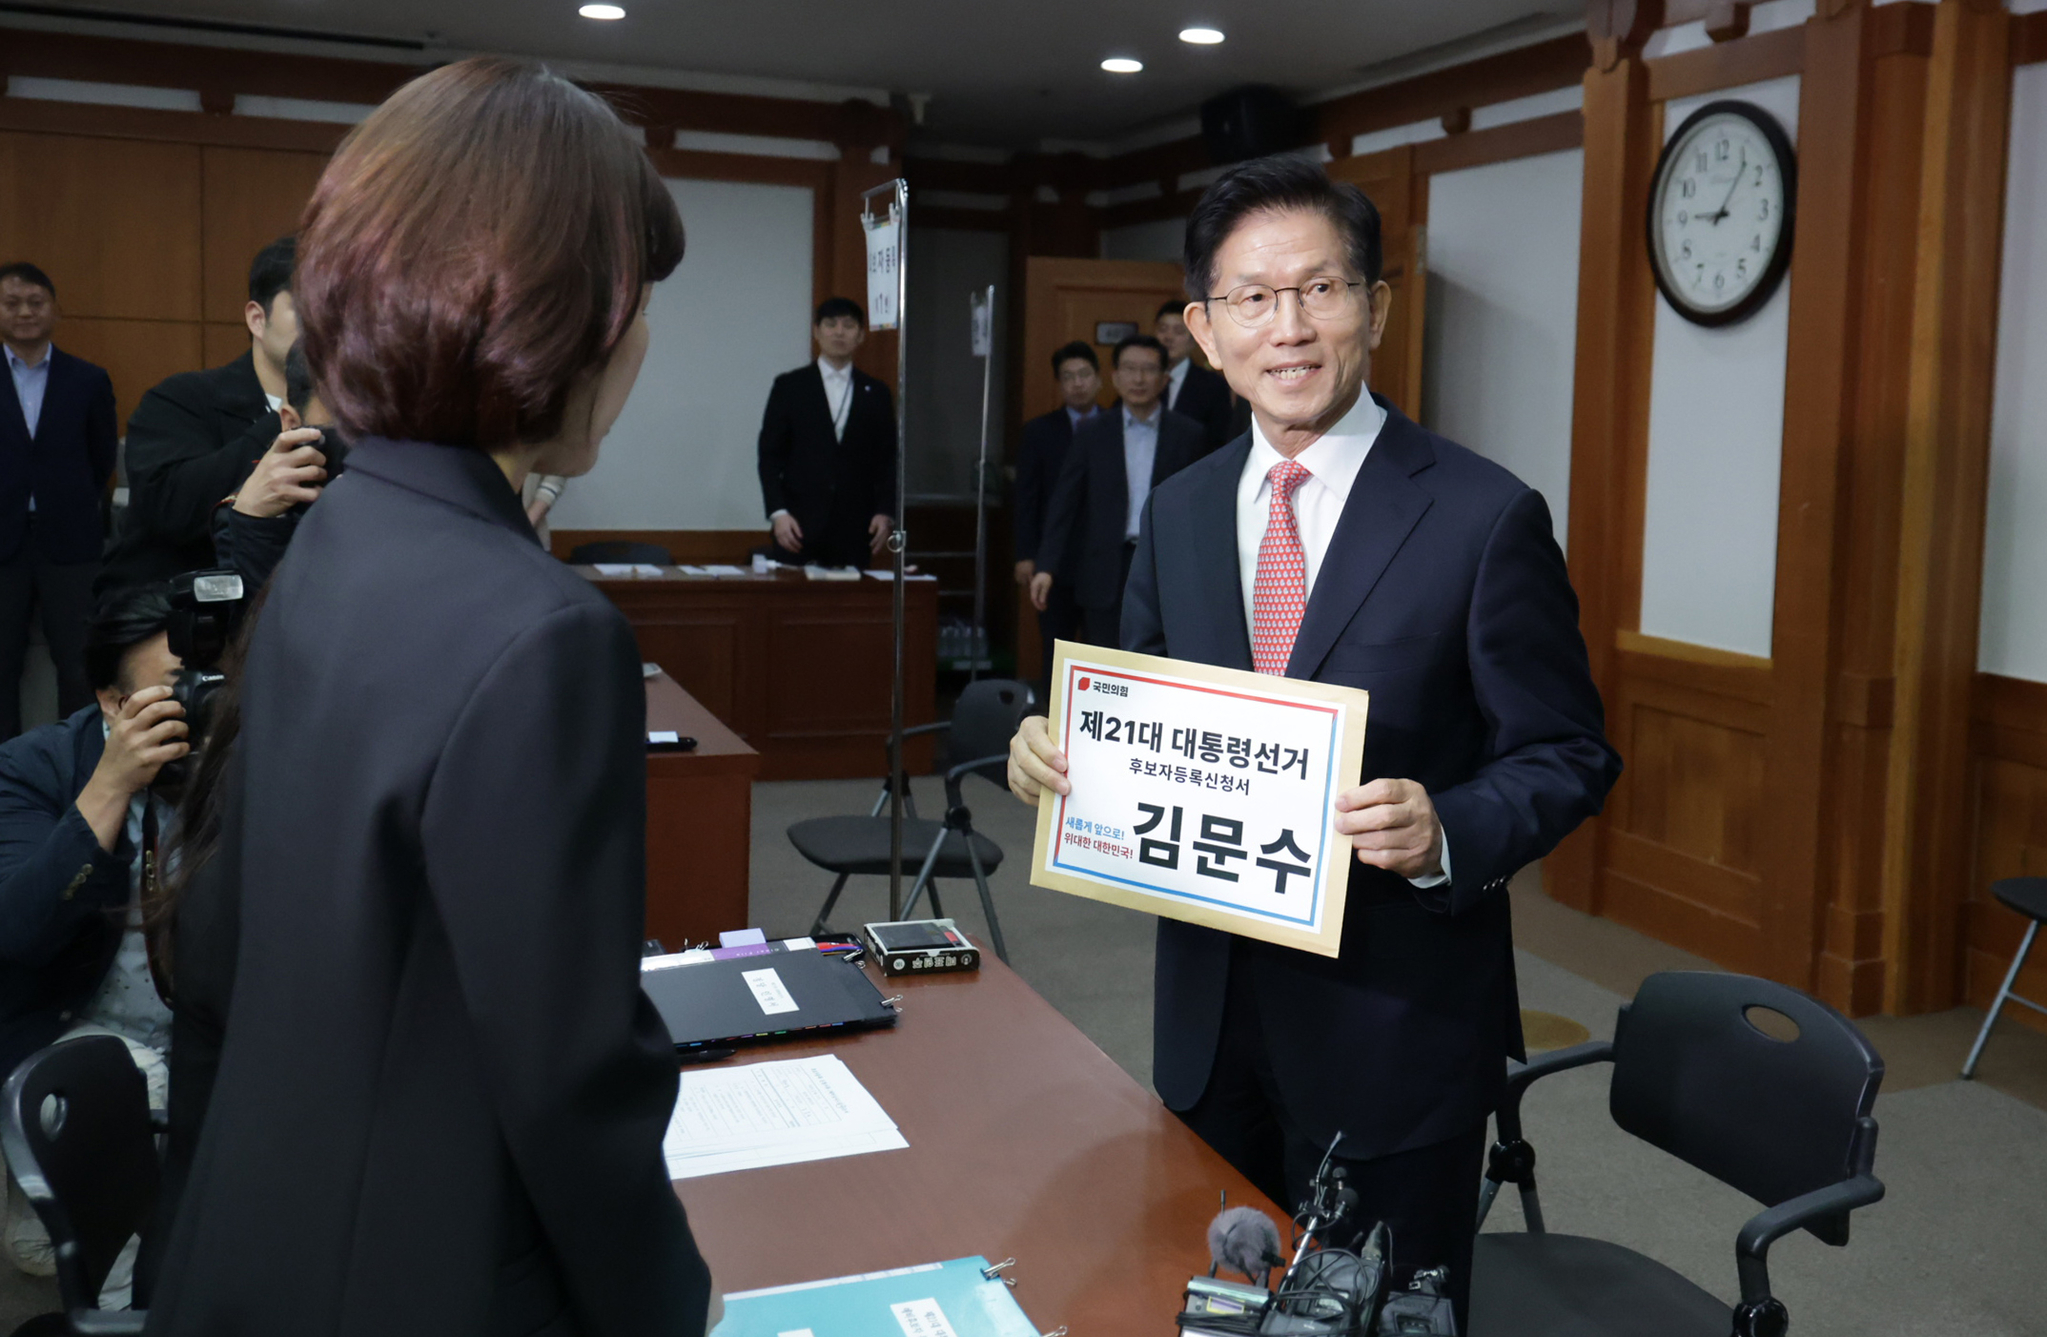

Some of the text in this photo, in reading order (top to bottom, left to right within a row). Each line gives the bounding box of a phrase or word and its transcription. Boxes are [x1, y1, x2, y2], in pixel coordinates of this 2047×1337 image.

[1715, 139, 1730, 161] 12
[1696, 152, 1708, 172] 11
[1753, 165, 1763, 187] 2
[1682, 178, 1696, 198] 10
[1678, 209, 1688, 227] 9
[1758, 198, 1769, 221] 3
[1682, 240, 1692, 260] 8
[1751, 233, 1761, 254] 4
[1696, 263, 1705, 282] 7
[1714, 270, 1724, 289] 6
[1736, 258, 1747, 280] 5
[201, 673, 225, 682] Canon
[1092, 680, 1129, 698] 국민의힘
[1079, 710, 1310, 780] 제21대 대통령선거
[1128, 757, 1251, 796] 후보자등록신청서
[1064, 816, 1125, 841] 새롭게 앞으로!
[1063, 832, 1134, 859] 위대한 대한민국!
[1132, 801, 1312, 894] 김문수
